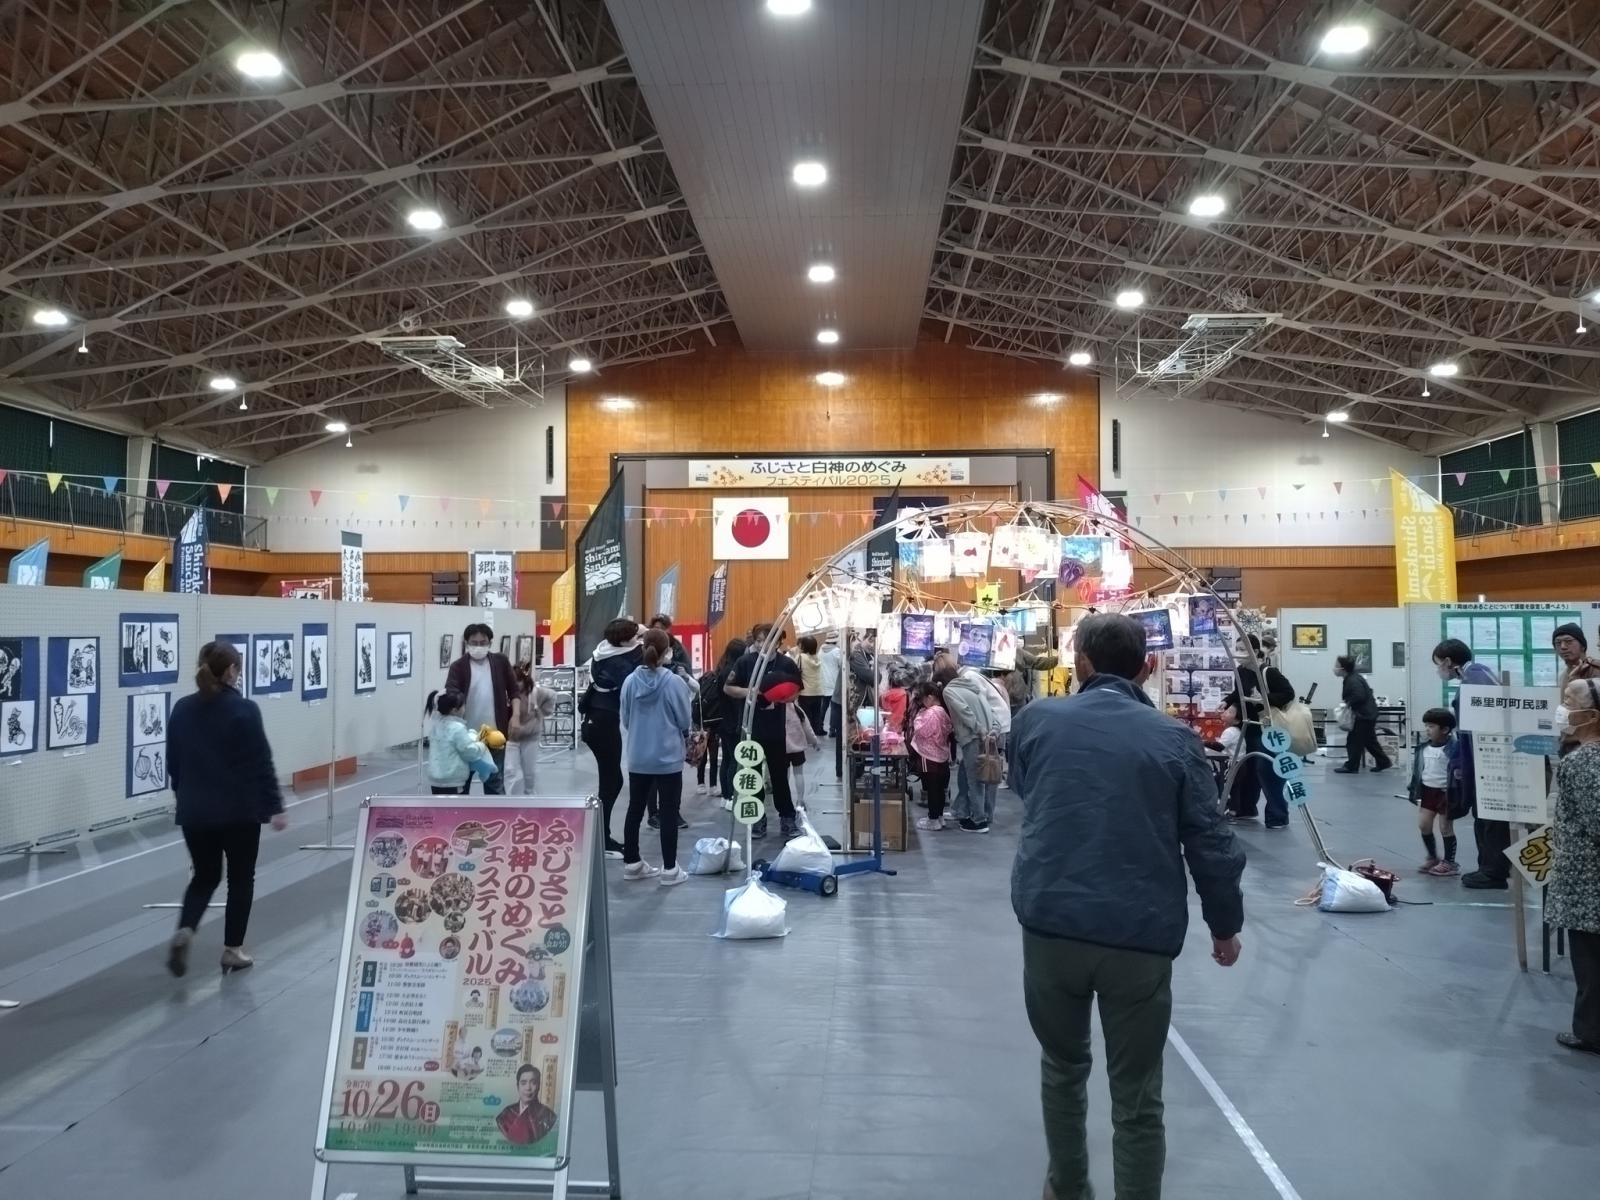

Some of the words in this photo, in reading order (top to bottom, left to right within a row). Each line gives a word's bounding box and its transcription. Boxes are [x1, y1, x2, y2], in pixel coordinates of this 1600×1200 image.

[751, 461, 906, 474] ふじさと白神のめぐみ
[767, 475, 891, 486] フェスティバル2025
[1470, 696, 1549, 710] 藤里町町民課
[739, 745, 758, 818] 幼稚園
[1267, 731, 1307, 801] 作品展
[465, 819, 507, 976] フェスティバル
[494, 819, 541, 986] 白神のめぐみ
[538, 819, 575, 928] ふじさと
[340, 1079, 425, 1121] 10/26
[422, 1102, 438, 1122] 日
